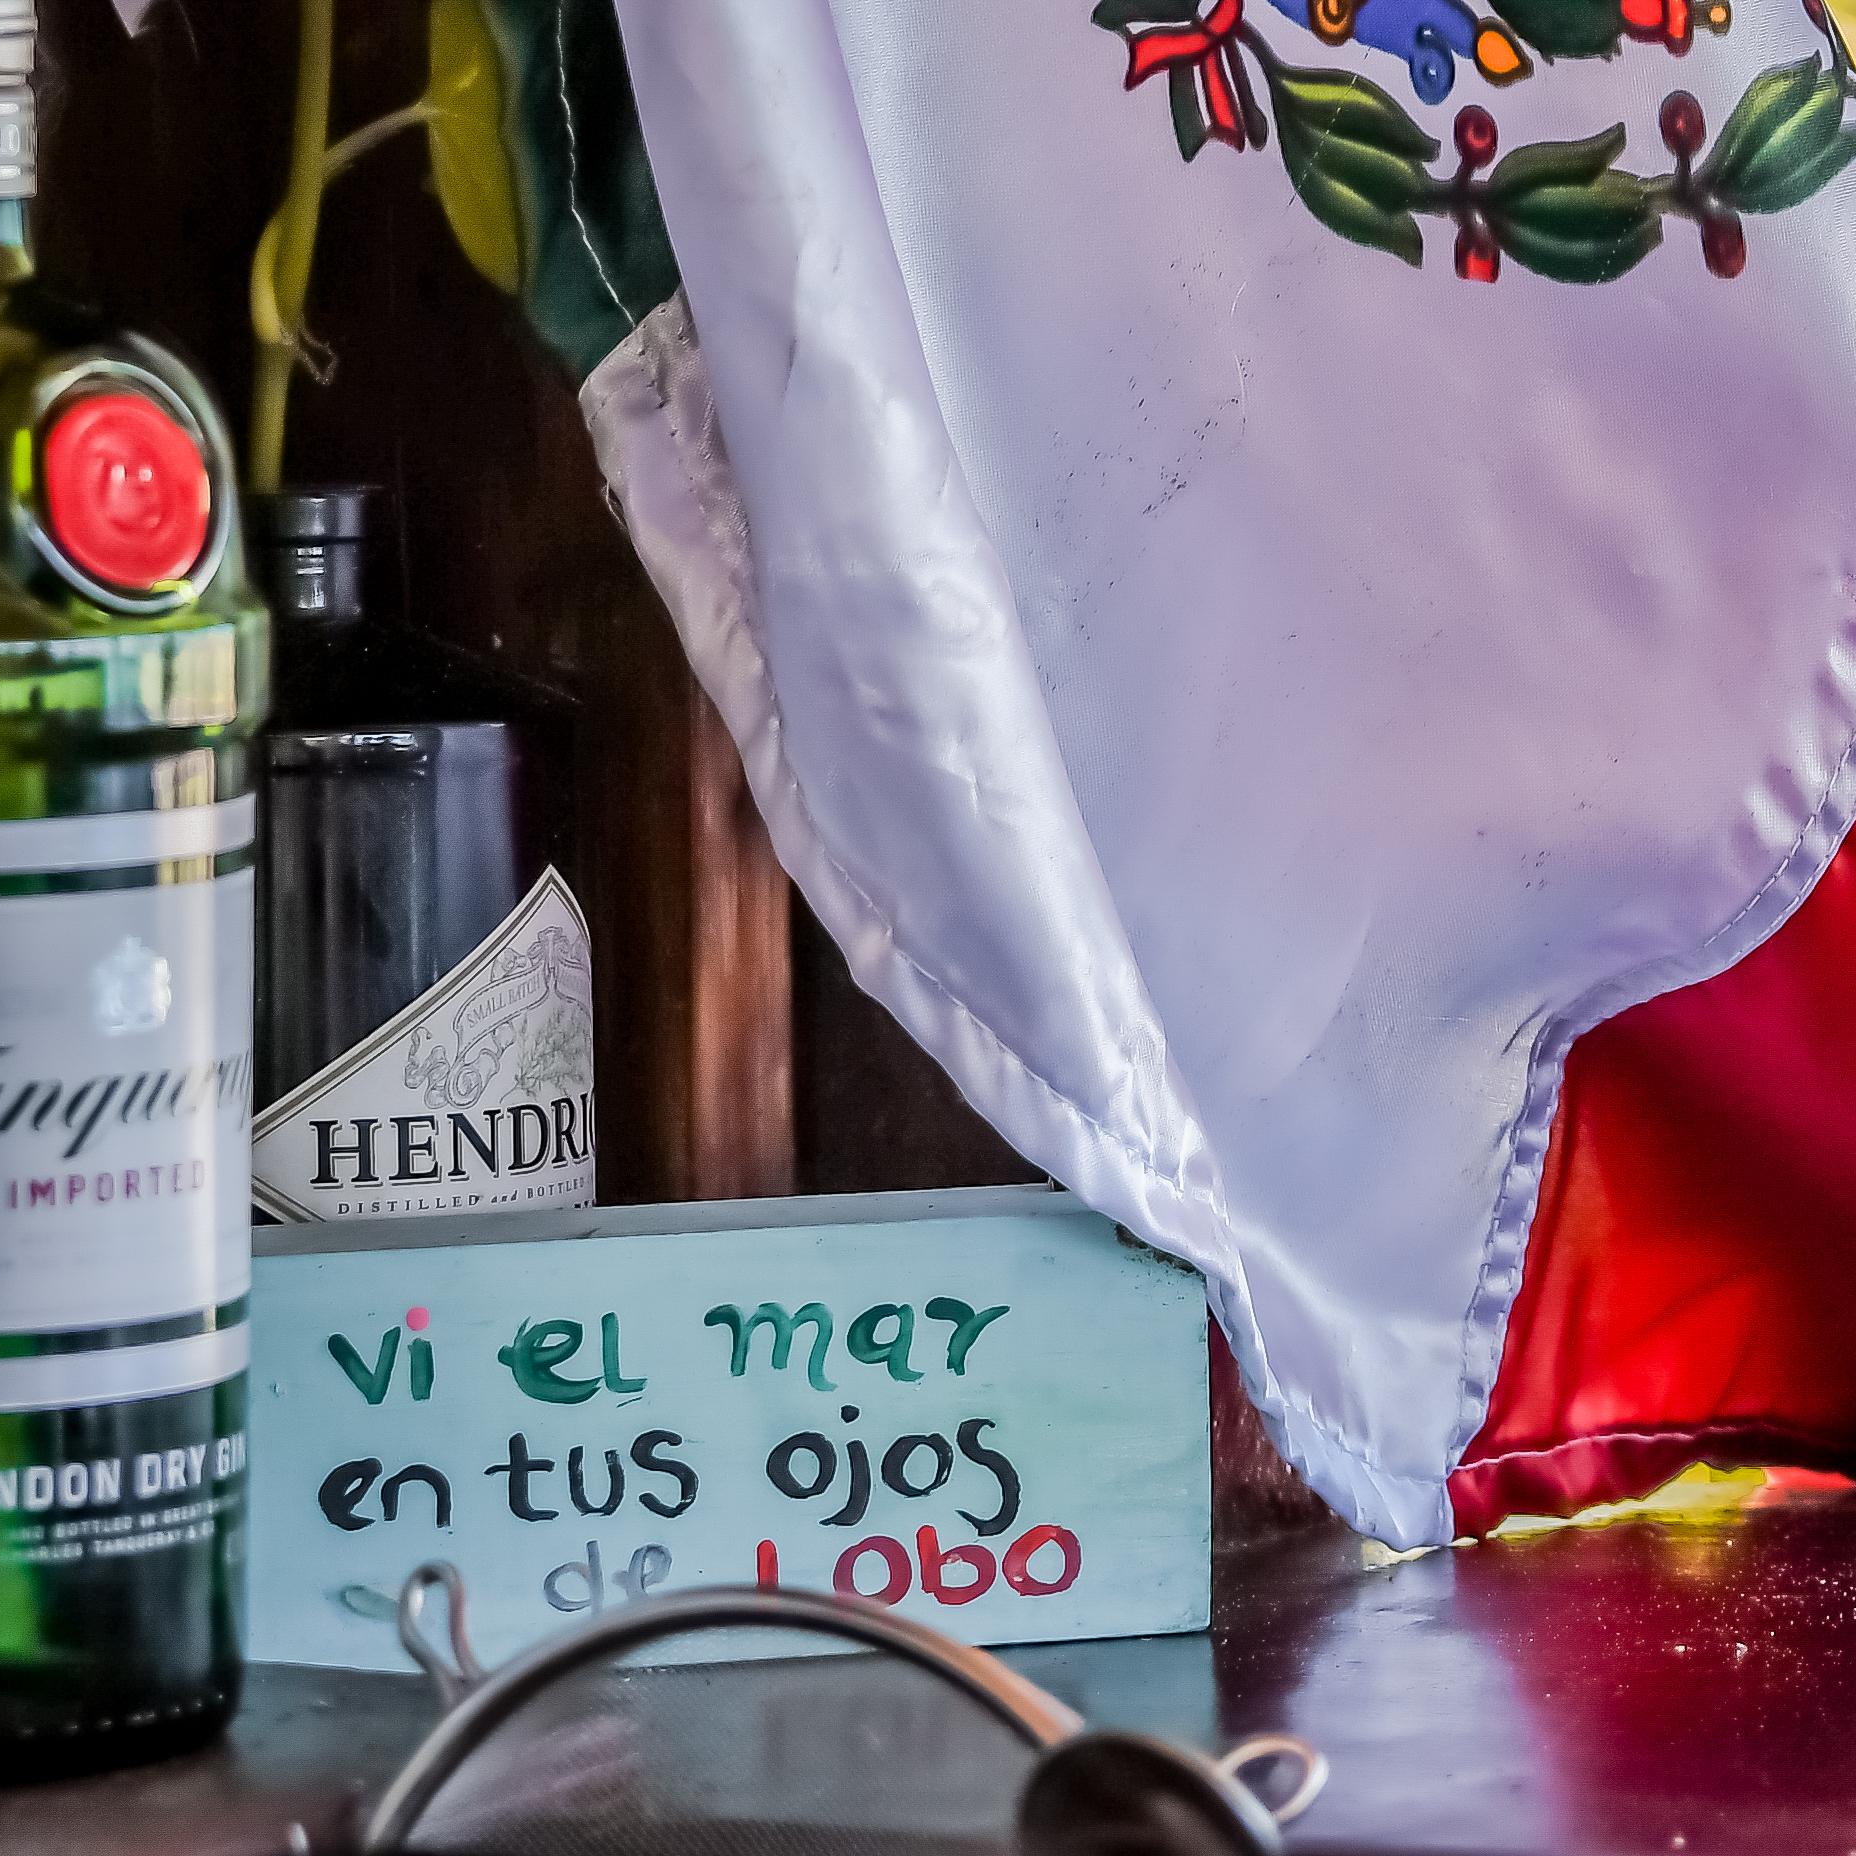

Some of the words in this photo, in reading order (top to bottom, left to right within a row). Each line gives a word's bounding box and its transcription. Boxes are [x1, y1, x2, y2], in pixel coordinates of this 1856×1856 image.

[466, 992, 507, 1029] SMALL
[309, 1091, 595, 1190] HENDRI
[7, 1159, 206, 1210] IMPORTED
[338, 1195, 480, 1215] DISTILLED
[490, 1190, 519, 1205] and
[328, 1304, 435, 1406] vi
[497, 1310, 648, 1406] el
[703, 1296, 1012, 1392] mar
[134, 1444, 206, 1498] DRY
[317, 1456, 453, 1532] en
[484, 1429, 700, 1523] tus
[765, 1404, 1022, 1537] ojos
[544, 1539, 673, 1614] de
